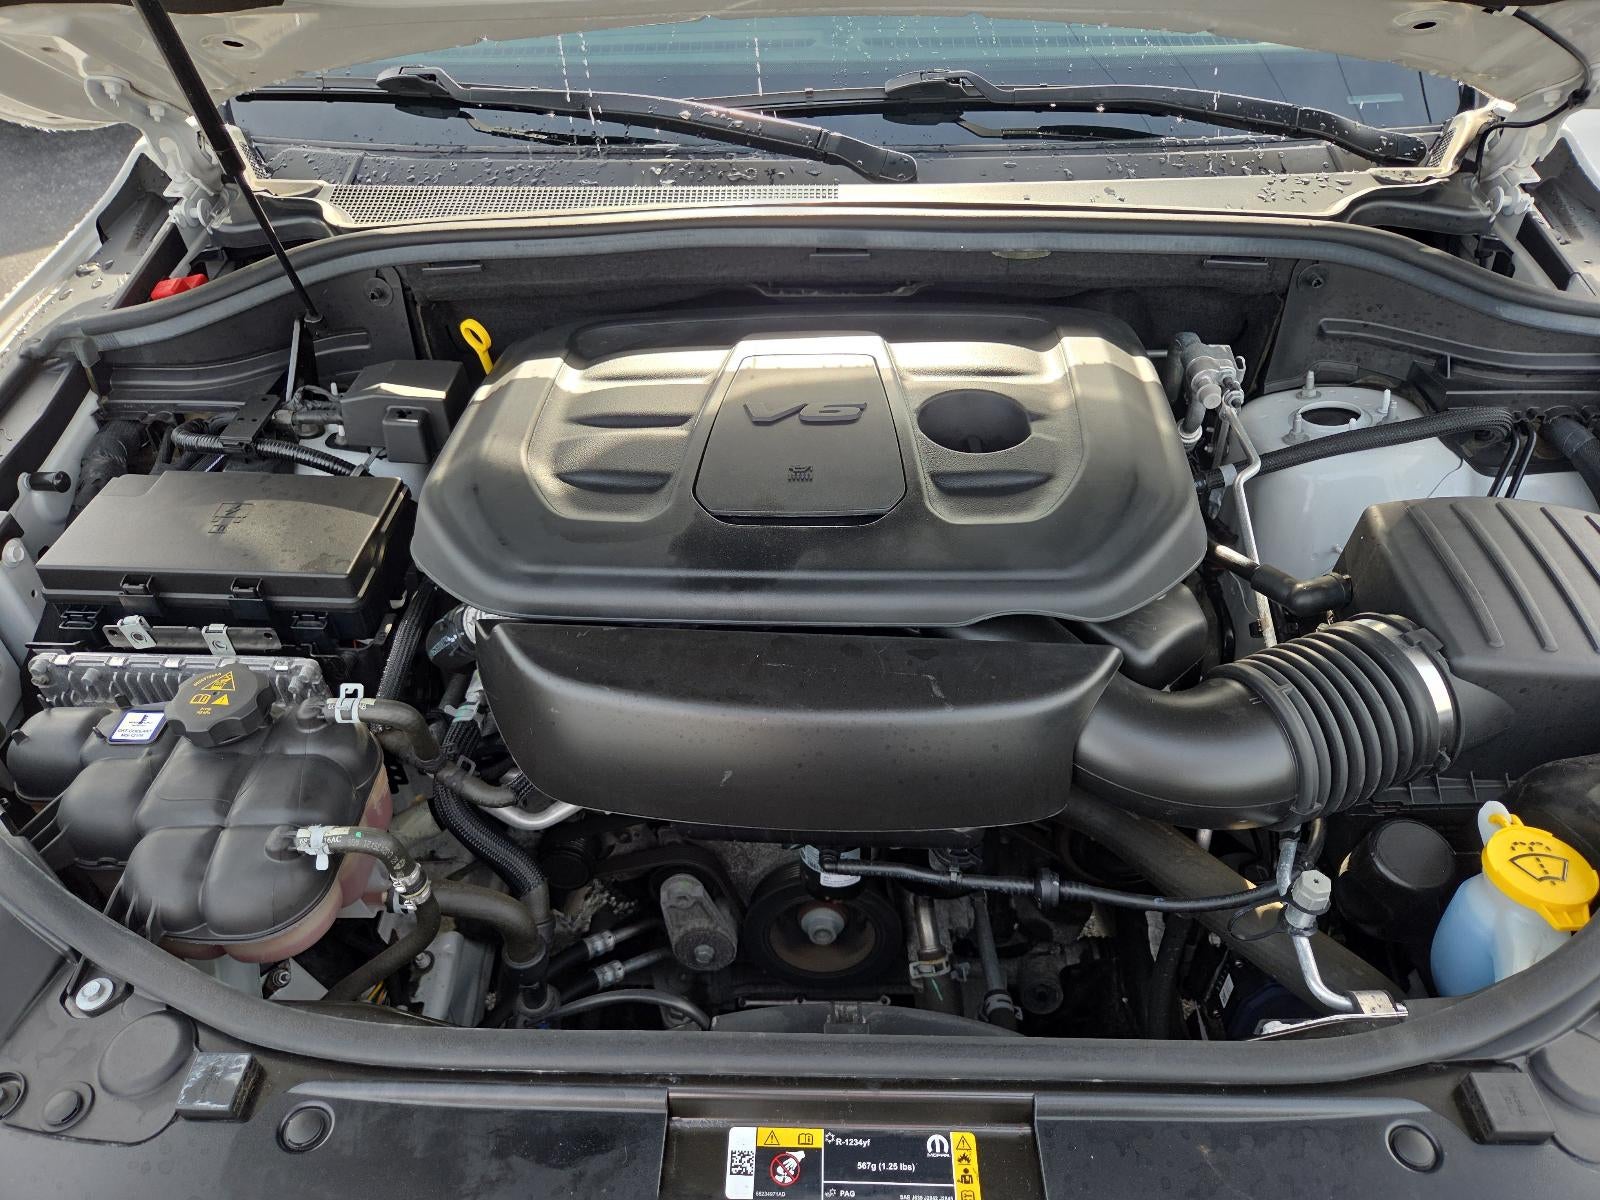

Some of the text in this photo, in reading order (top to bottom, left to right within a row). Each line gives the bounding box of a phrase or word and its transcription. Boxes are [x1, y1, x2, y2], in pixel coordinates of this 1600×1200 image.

[743, 400, 867, 426] V6
[836, 1138, 871, 1148] R-1234yf
[857, 1162, 916, 1173] 567g (1.25 lbs)
[840, 1190, 856, 1198] PAG
